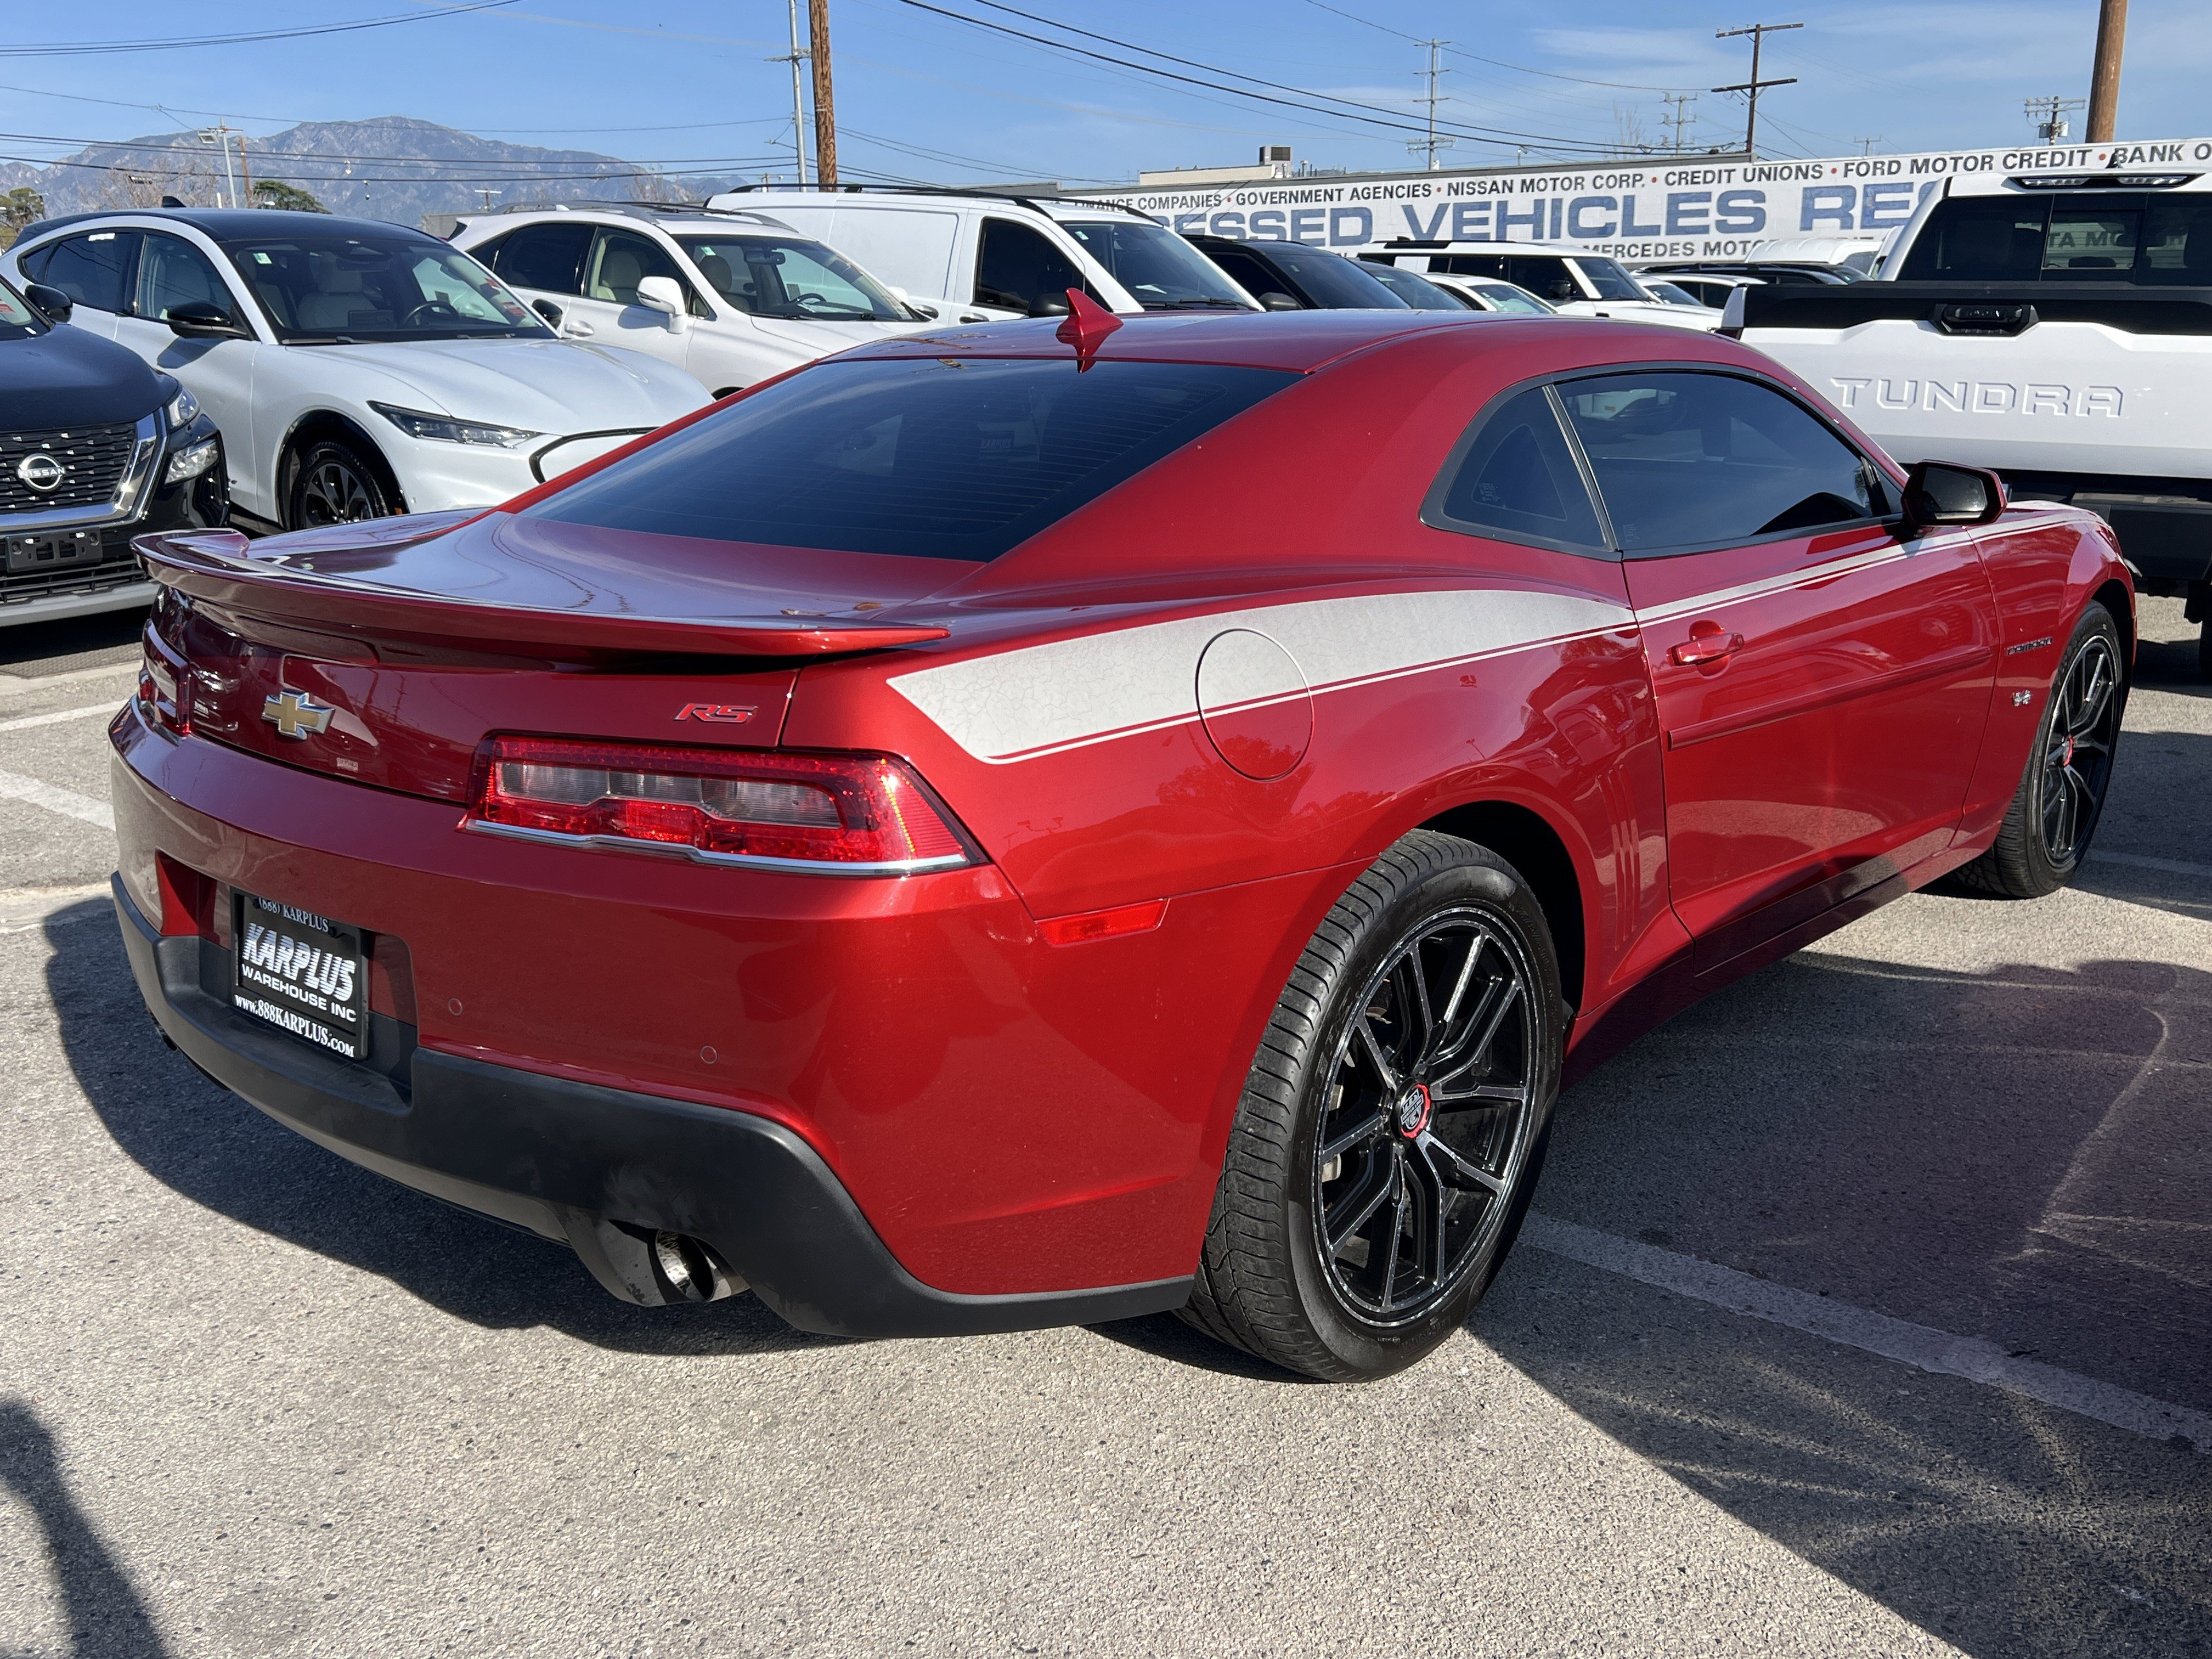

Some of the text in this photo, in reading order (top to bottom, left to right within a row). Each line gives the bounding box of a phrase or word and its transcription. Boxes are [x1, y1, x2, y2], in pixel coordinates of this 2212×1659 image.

[1137, 194, 1222, 210] COMPANIES
[1236, 188, 1344, 205] GOVERNMENT
[1350, 183, 1431, 201] AGENCIES
[1447, 179, 1514, 196] NISSAN
[1520, 176, 1585, 193] MOTOR
[1593, 173, 1645, 189] CORP.
[1665, 168, 1736, 186] CREDIT
[1743, 164, 1823, 182] UNIONS
[1843, 160, 1901, 178] FORD
[1909, 155, 1995, 174] MOTOR
[2002, 149, 2092, 169] CREDIT
[2114, 144, 2185, 163] BANK
[1401, 190, 1766, 240] VEHICLES
[1830, 377, 2124, 417] TUNDRA
[19, 467, 65, 478] NISSAN
[674, 703, 758, 723] RS
[283, 905, 329, 932] KARPLUS
[242, 922, 357, 1002] KARPLUS
[241, 963, 357, 1023] WAREHOUSE INC
